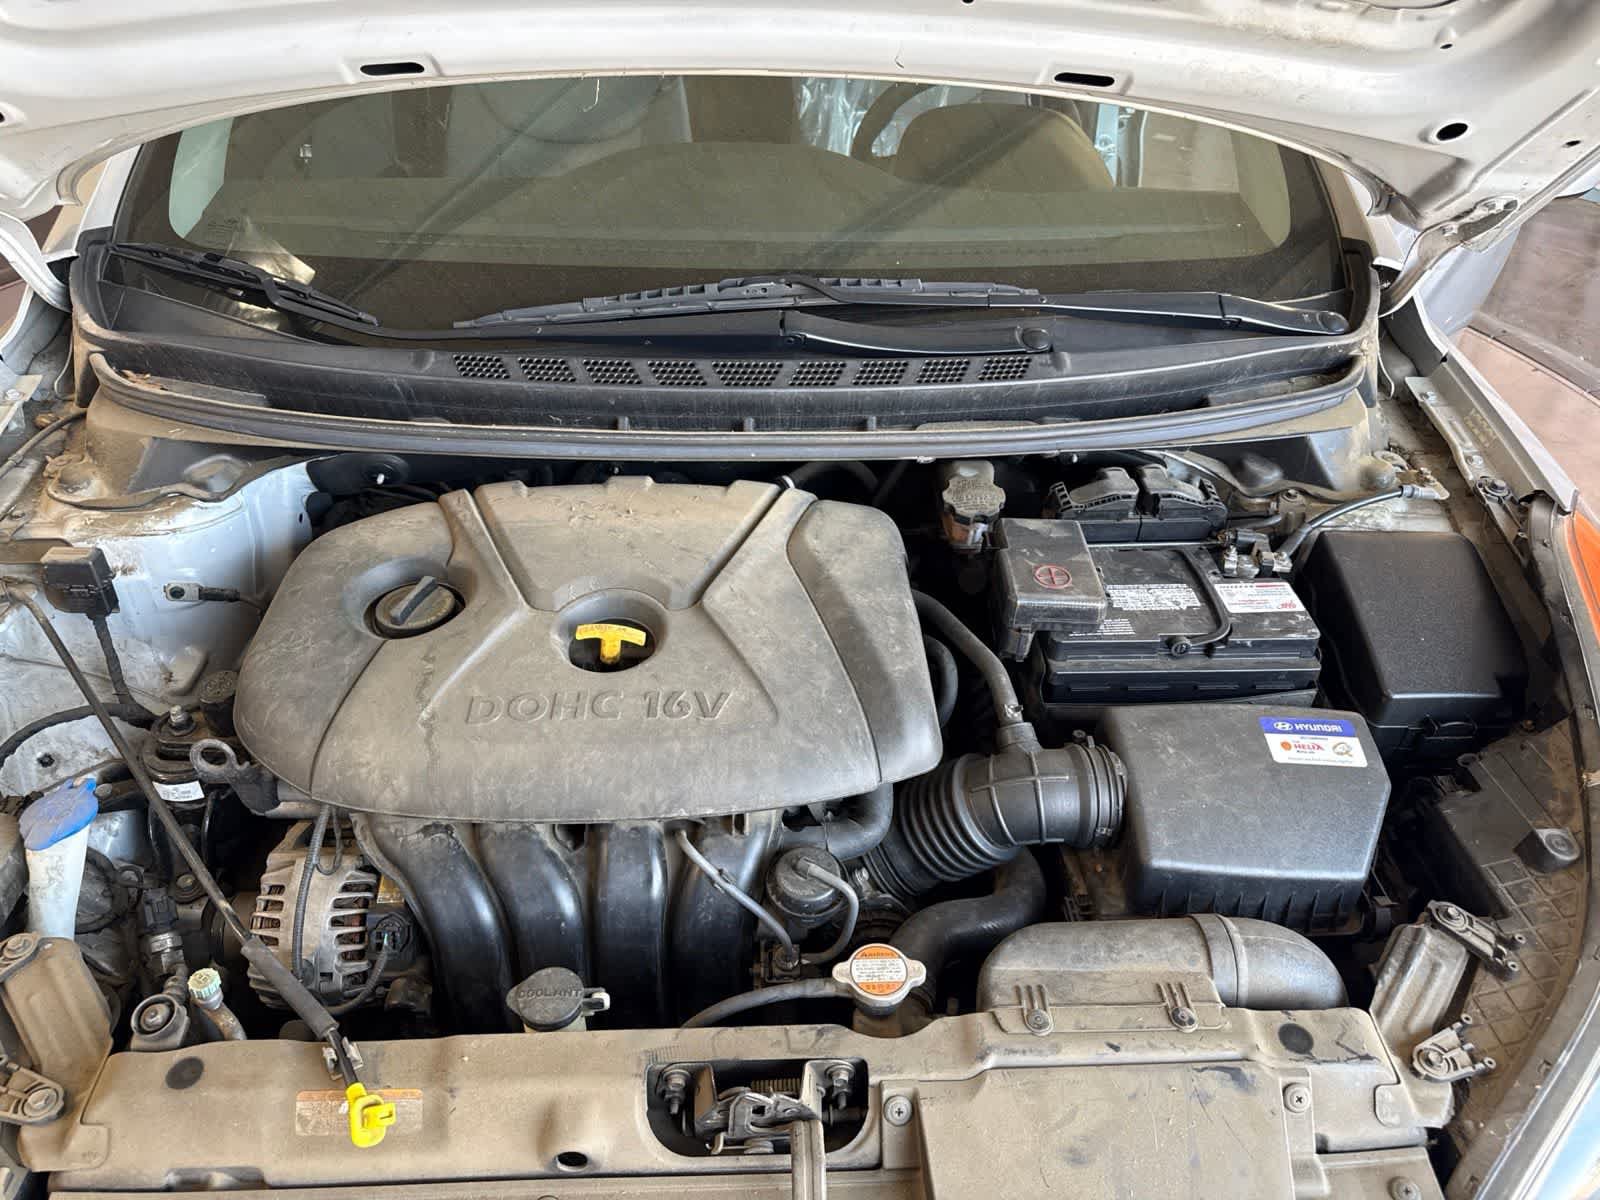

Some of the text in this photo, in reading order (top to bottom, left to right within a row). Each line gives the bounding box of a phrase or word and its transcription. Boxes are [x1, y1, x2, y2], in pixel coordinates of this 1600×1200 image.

[464, 688, 735, 726] DOHC 16V
[1294, 723, 1343, 733] HYUNDAI
[517, 986, 582, 1000] COOLANT
